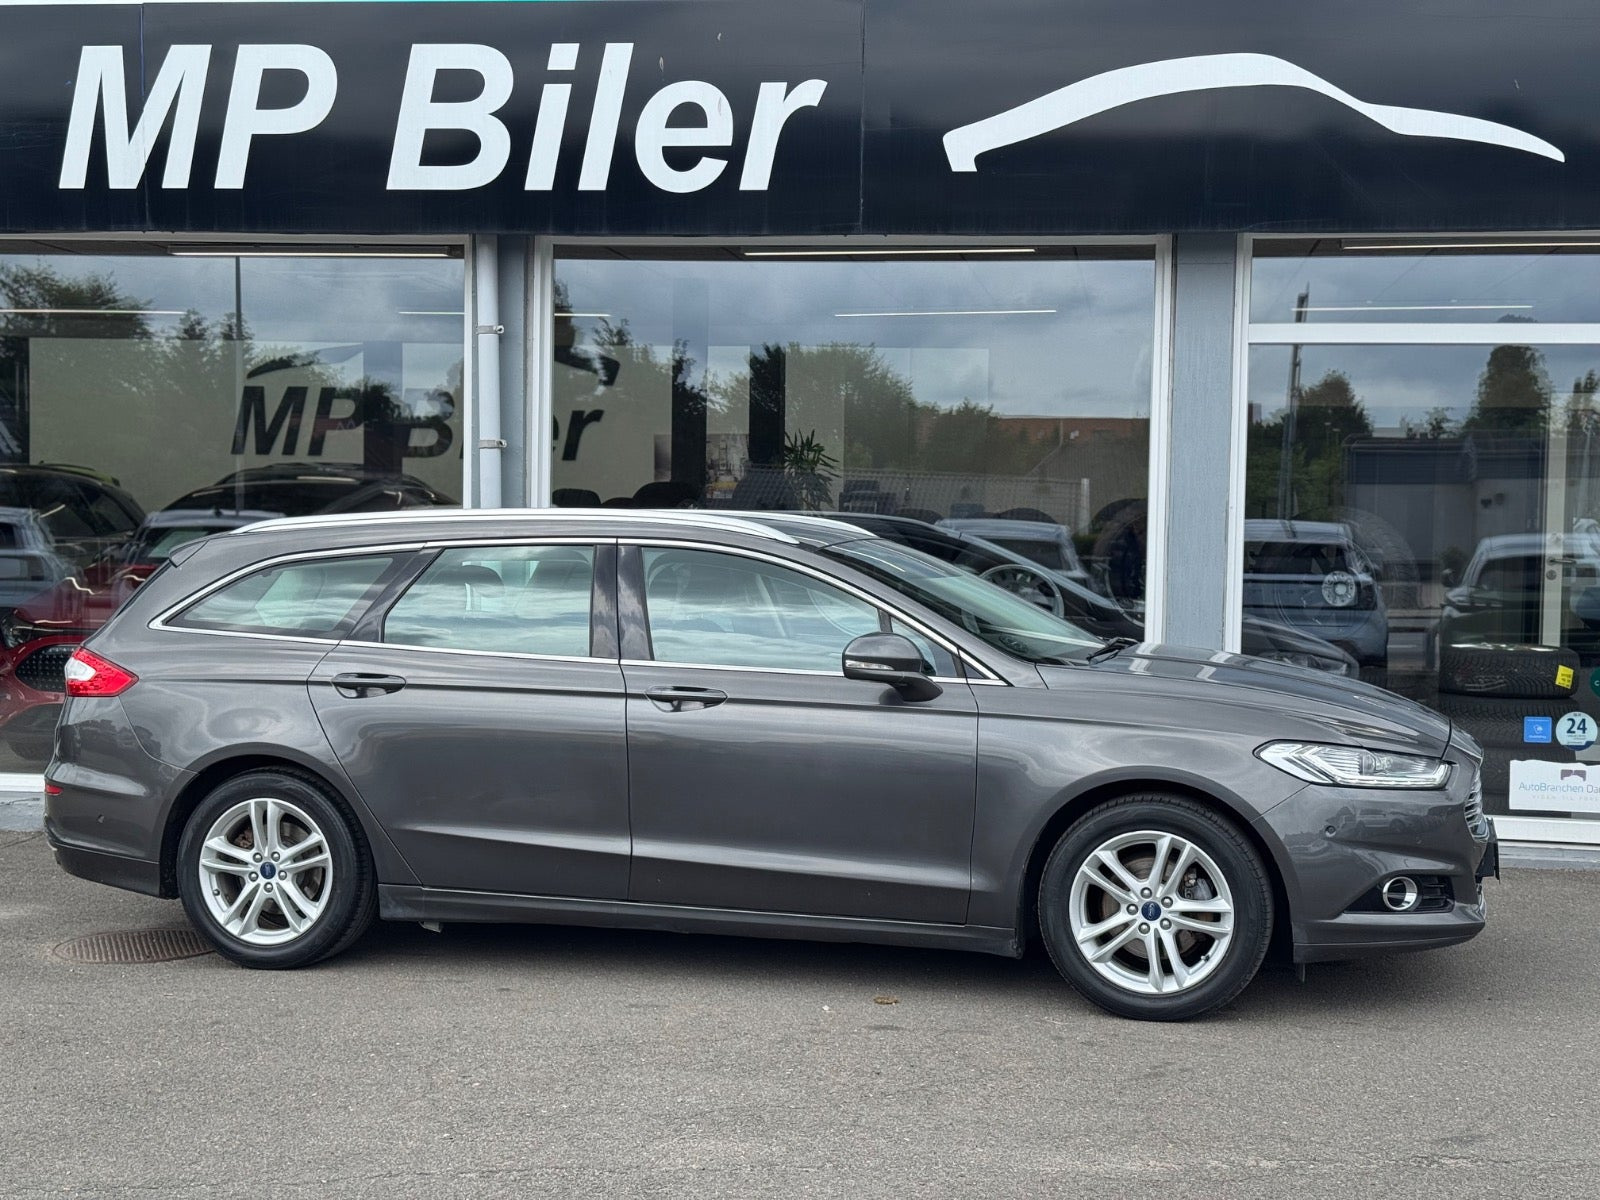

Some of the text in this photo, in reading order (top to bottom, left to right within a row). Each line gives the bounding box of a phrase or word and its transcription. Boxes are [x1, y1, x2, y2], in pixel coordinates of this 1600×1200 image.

[59, 42, 828, 194] MP Biler
[231, 386, 367, 456] MP
[1566, 718, 1587, 734] 24
[1519, 782, 1600, 794] AutoBranchen Da
